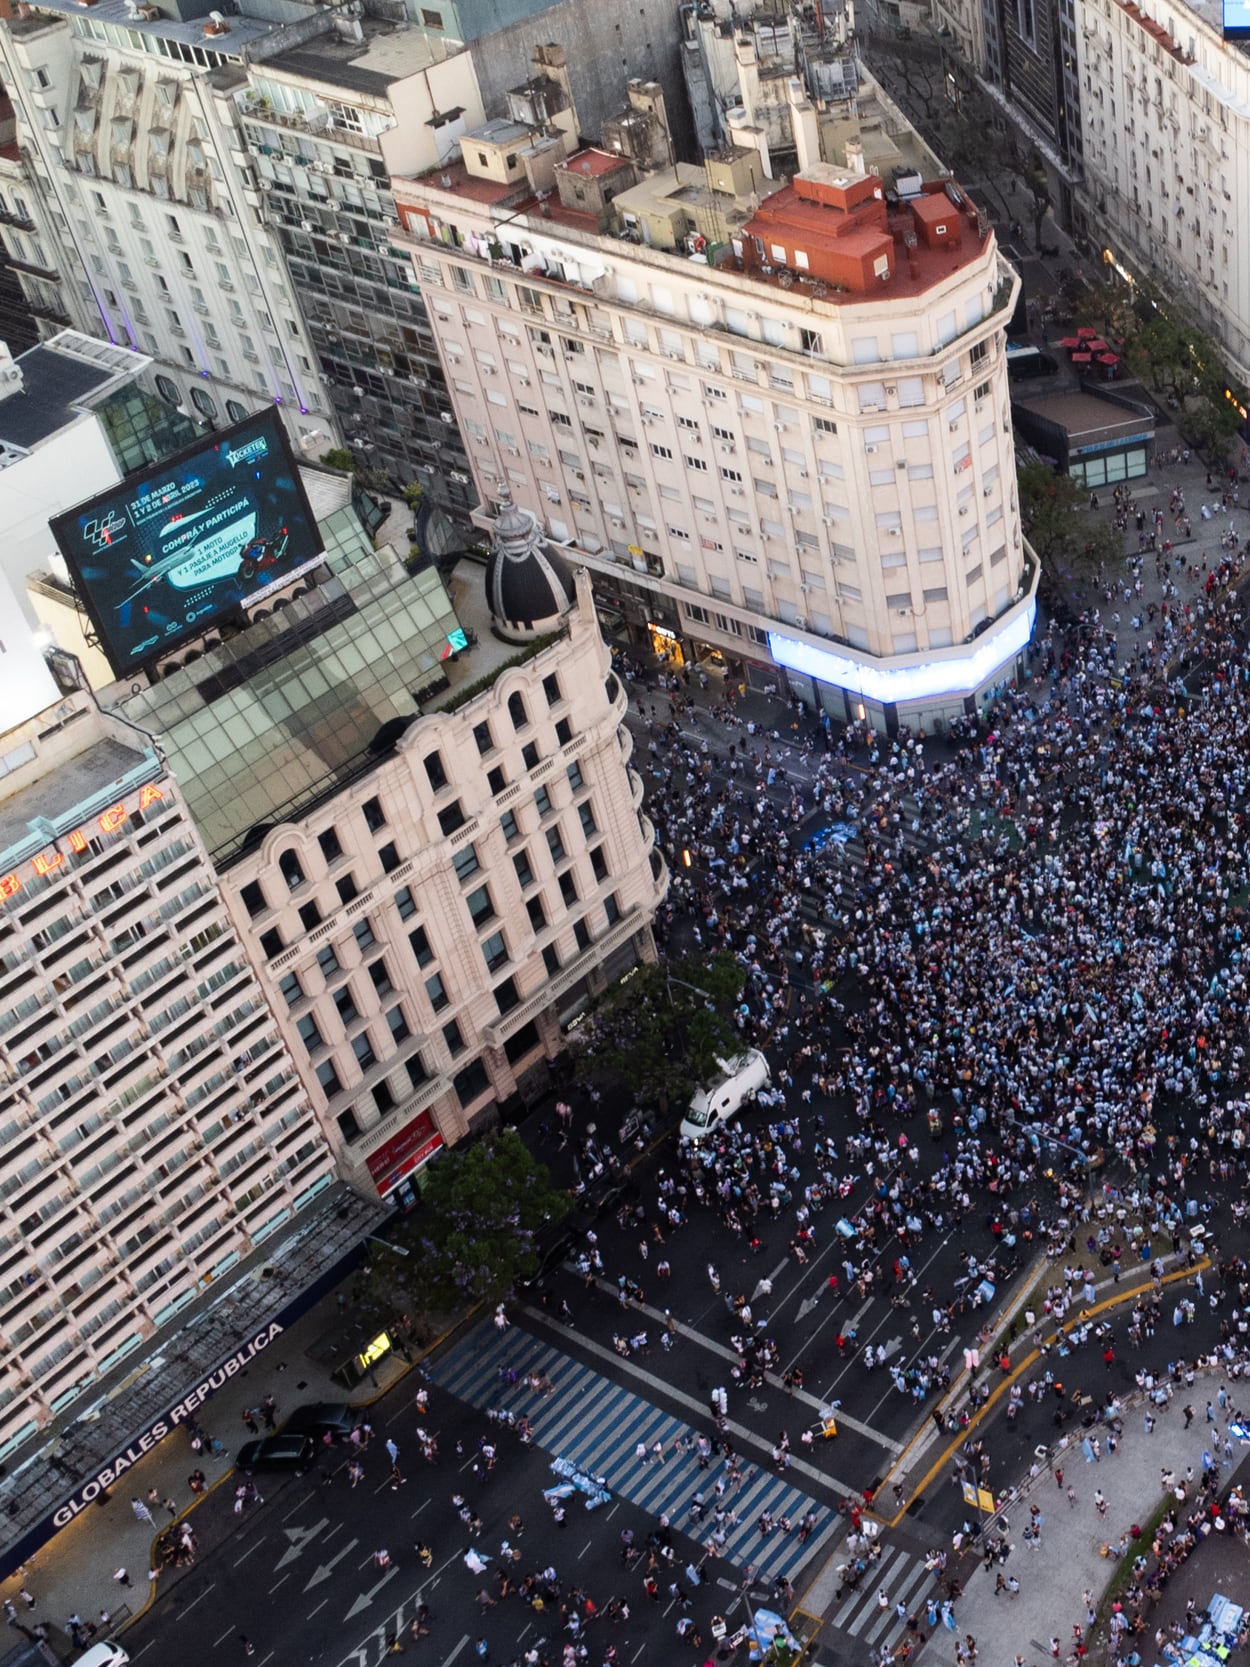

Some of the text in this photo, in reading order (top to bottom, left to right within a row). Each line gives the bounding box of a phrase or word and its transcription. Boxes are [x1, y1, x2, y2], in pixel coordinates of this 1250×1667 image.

[229, 437, 267, 464] TICKETEK
[131, 482, 176, 510] 31 DE MARZO
[134, 510, 140, 518] 1
[152, 498, 162, 509] DE
[162, 489, 182, 504] ABRIL
[181, 479, 200, 493] 2023
[162, 526, 199, 554] COMPRÁ
[205, 497, 250, 529] PARTICIPÁ
[189, 554, 212, 570] PASAJE
[219, 531, 248, 551] MUGELLO
[203, 537, 223, 551] MOTO
[193, 563, 211, 576] PARA
[52, 1322, 285, 1529] GLOBALES REPÚBLICA
